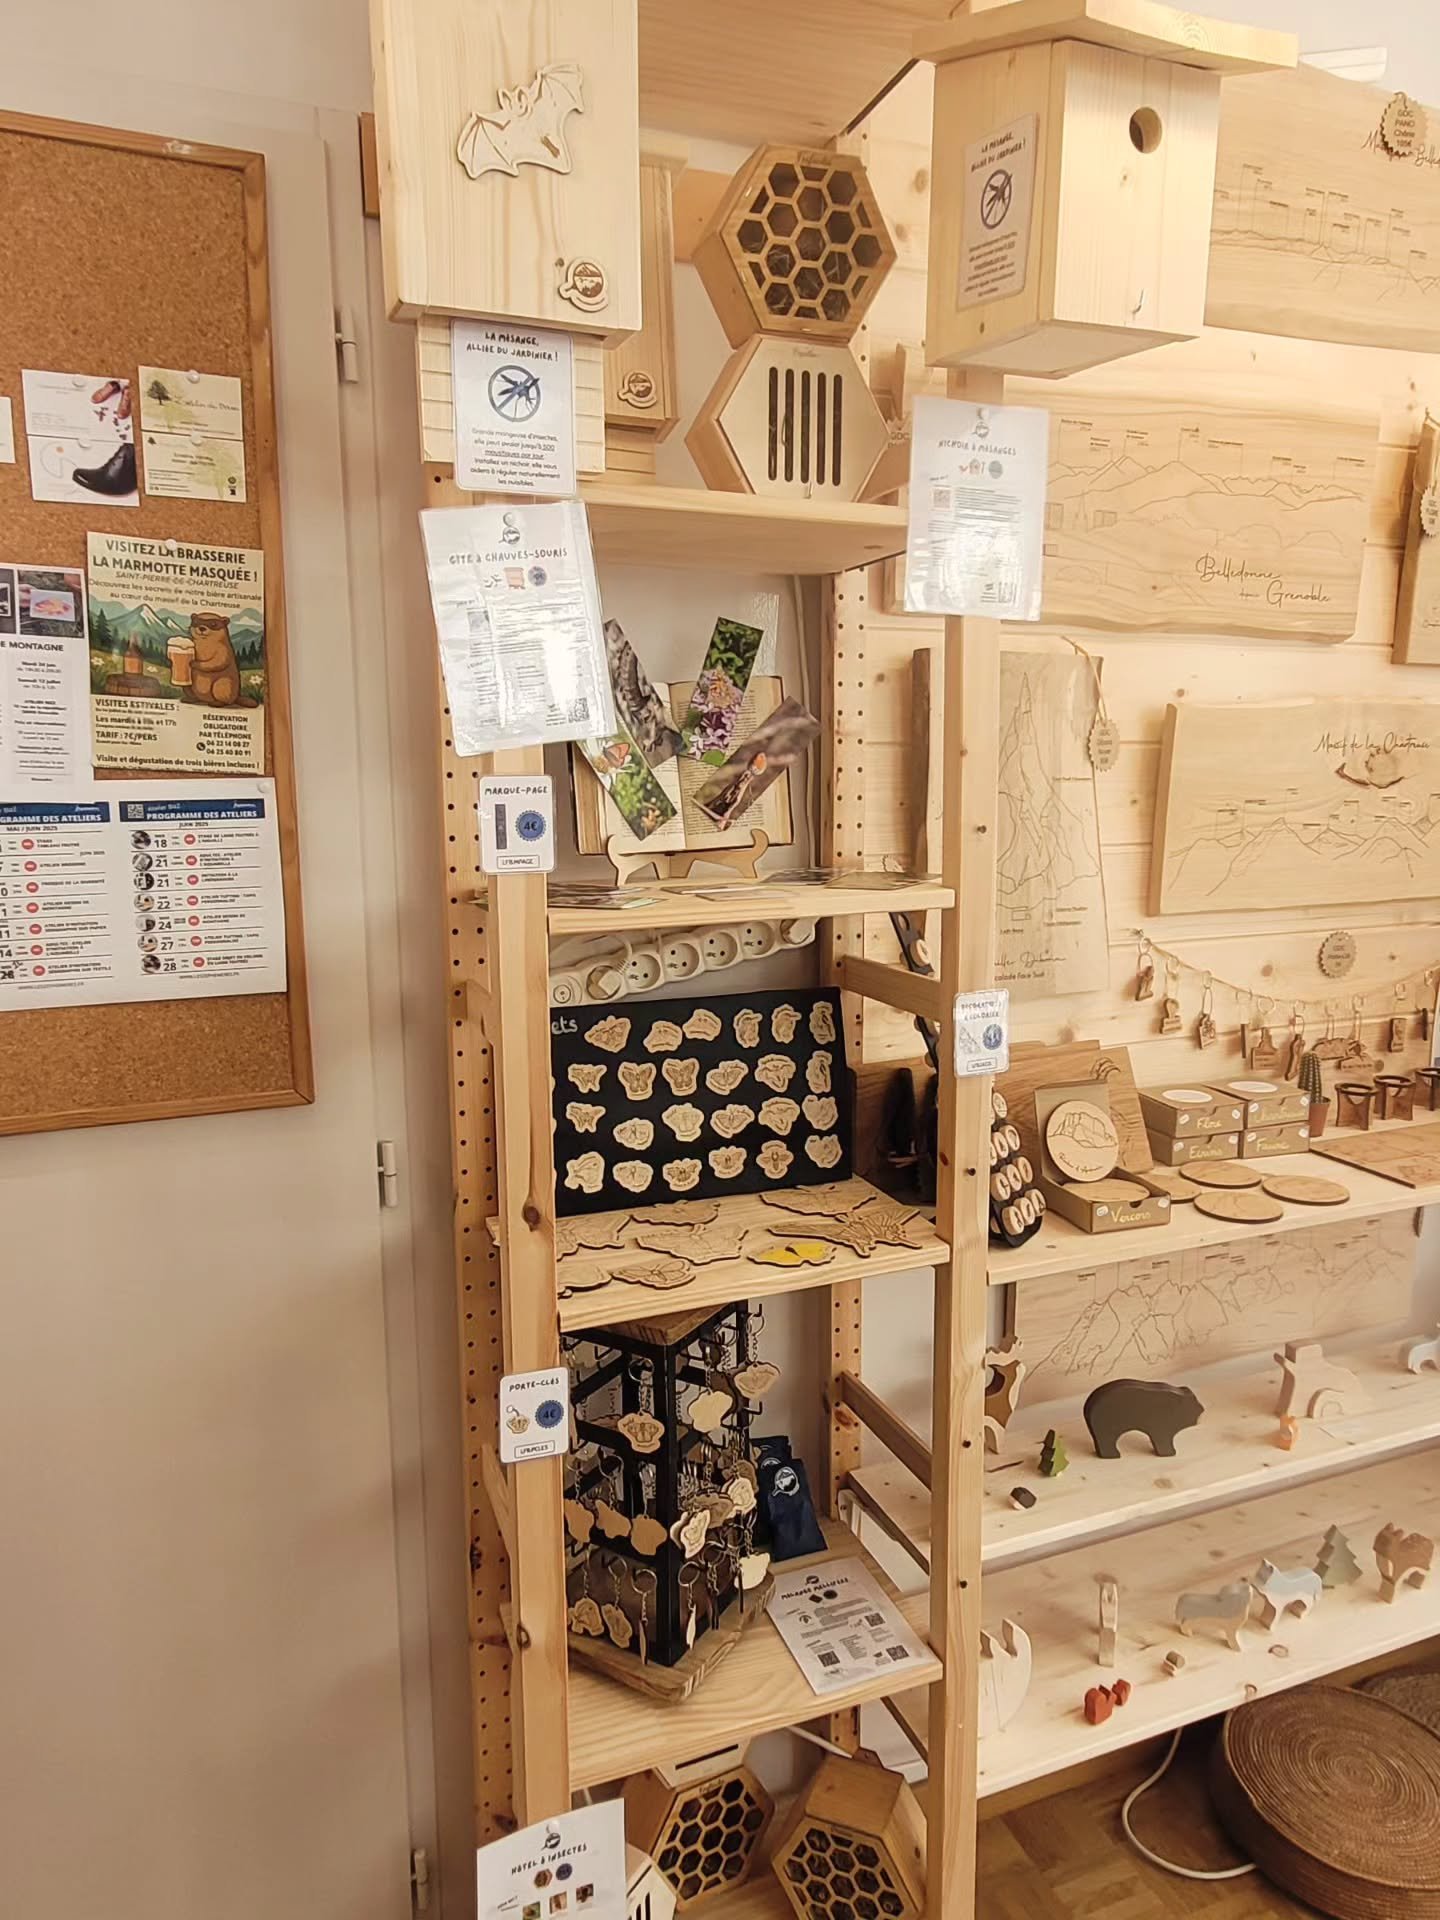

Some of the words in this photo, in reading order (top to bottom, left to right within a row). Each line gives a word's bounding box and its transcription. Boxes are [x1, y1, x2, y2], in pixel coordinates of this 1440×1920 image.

[485, 332, 495, 340] LA
[497, 346, 508, 354] DU
[511, 349, 552, 360] JARDINIER
[556, 352, 557, 361] !
[106, 540, 154, 554] VISITEZ
[159, 545, 175, 558] LA
[177, 548, 245, 564] BRASSERIE
[485, 548, 567, 562] CHAUVES-SOURIS
[93, 556, 109, 568] LA
[112, 558, 185, 576] MARMOTTE
[190, 566, 251, 581] MASQUÉE
[254, 572, 257, 582] !
[1196, 553, 1281, 583] Belledonne
[207, 588, 225, 599] bière
[227, 592, 262, 601] artisanale
[1267, 580, 1330, 608] Grenoble
[200, 599, 240, 608] Chartreuse
[9, 642, 64, 651] MONTAGNE
[96, 699, 128, 707] VISITES
[130, 701, 175, 710] ESTIVALES
[203, 713, 248, 722] RÉSERVATION
[96, 755, 118, 763] Visite
[129, 756, 173, 767] dégustation
[175, 758, 184, 766] de
[186, 759, 202, 767] trois
[203, 759, 225, 768] bières
[227, 759, 254, 769] incluses
[485, 786, 547, 795] MARQUE-PAGE
[146, 812, 201, 820] PROGRAMME
[524, 821, 537, 831] 4€
[155, 840, 167, 848] 18
[156, 859, 168, 867] 21
[157, 879, 169, 887] 21
[157, 901, 170, 909] 22
[158, 922, 172, 930] 24
[161, 942, 174, 950] 27
[163, 963, 177, 971] 28
[1111, 1207, 1151, 1222] Vercors
[509, 1377, 559, 1392] PORTE-CLÉS
[543, 1410, 556, 1418] 4€
[511, 1861, 538, 1875] HÔTEL
[548, 1843, 587, 1862] INSECTES
